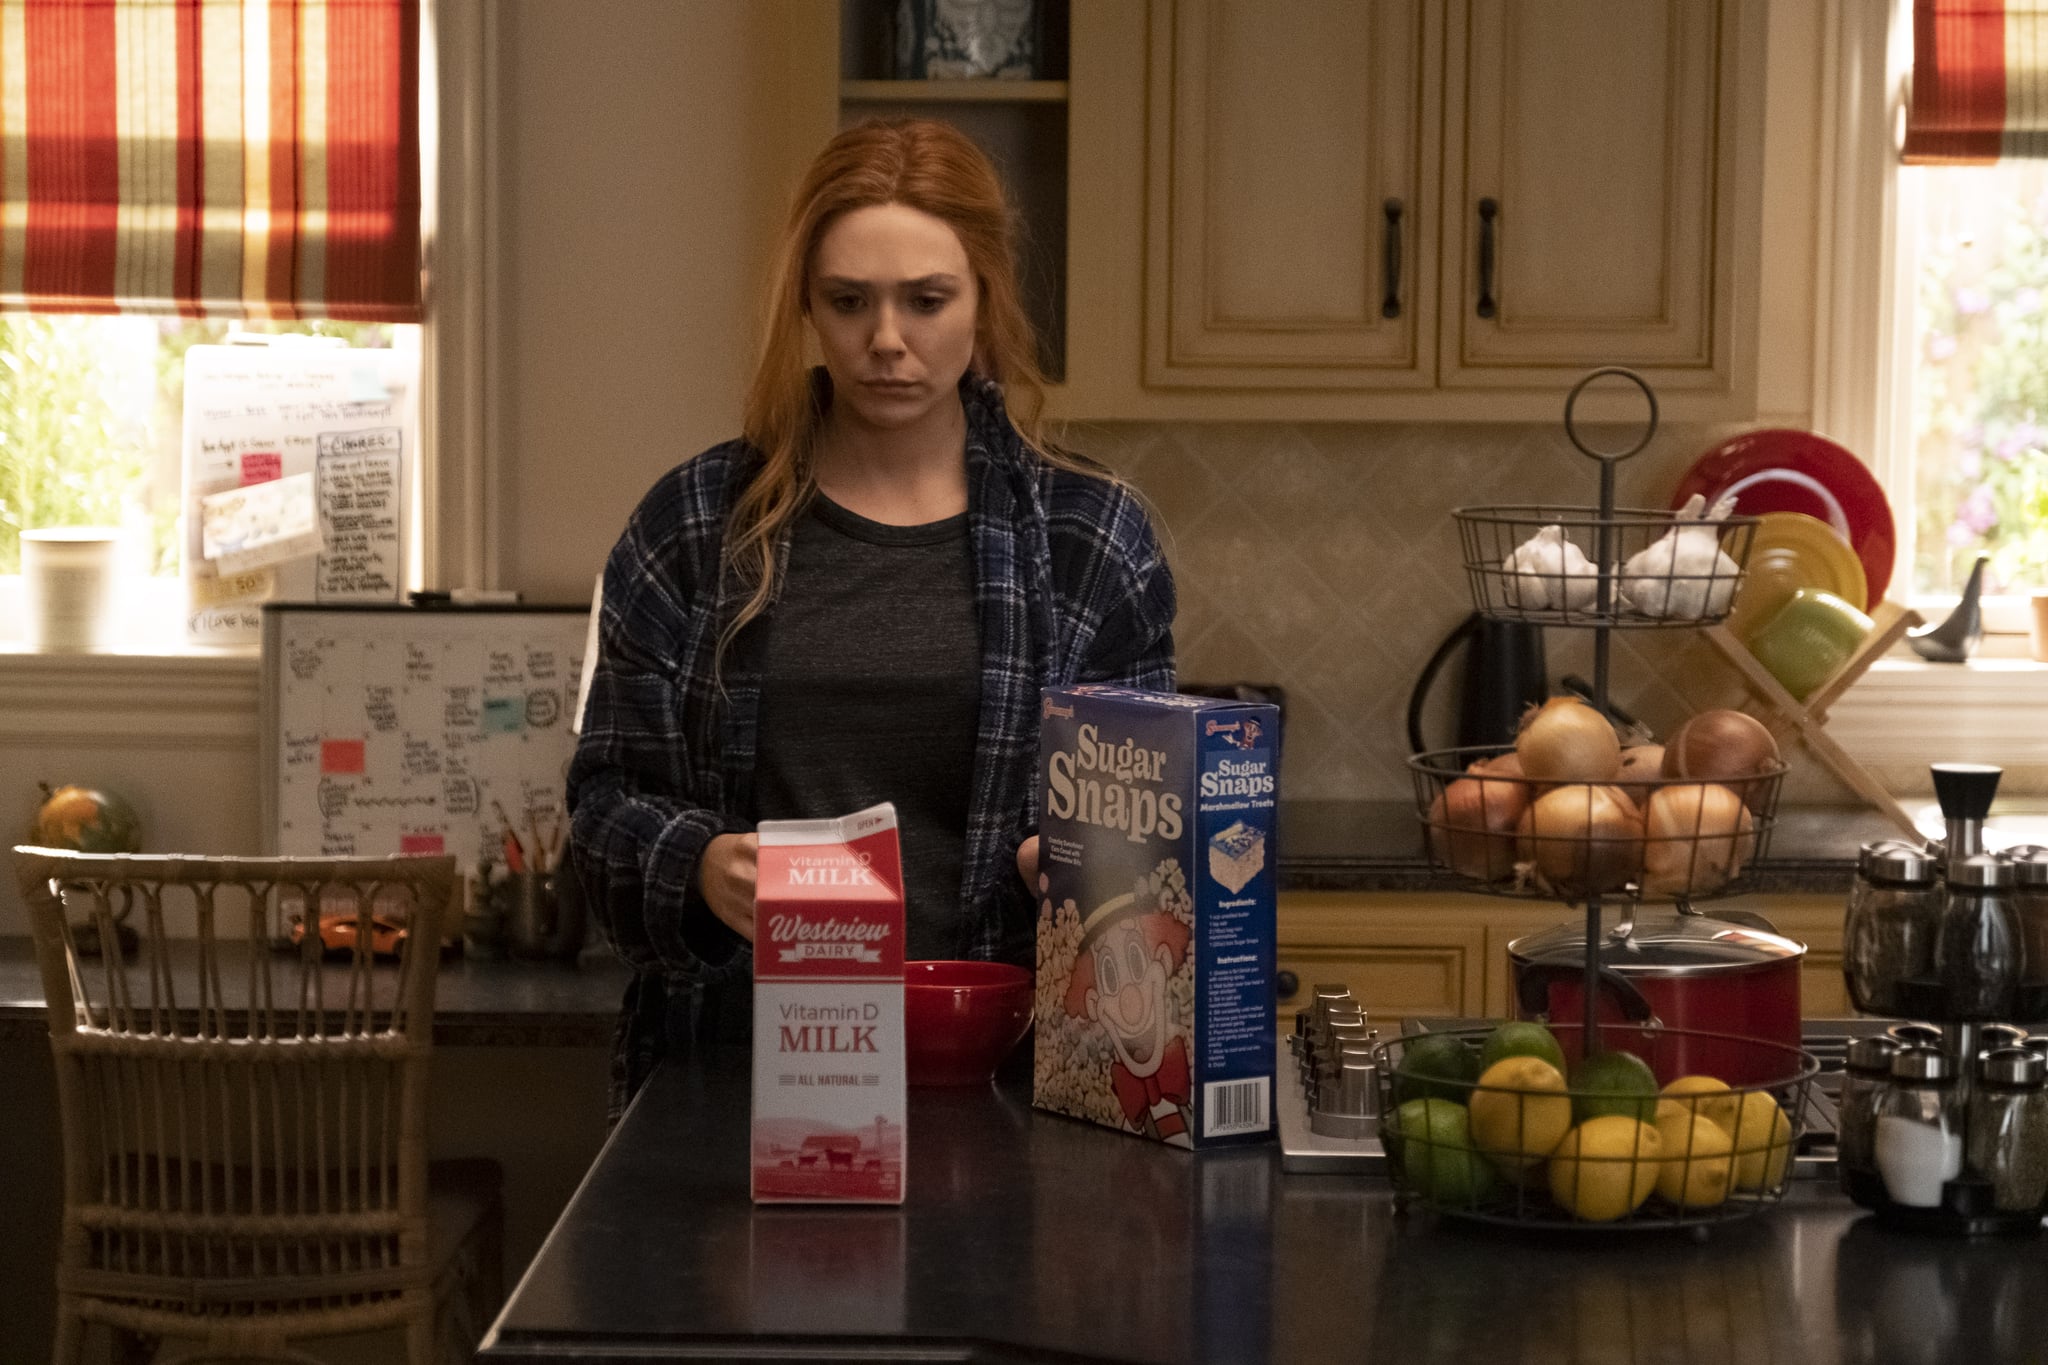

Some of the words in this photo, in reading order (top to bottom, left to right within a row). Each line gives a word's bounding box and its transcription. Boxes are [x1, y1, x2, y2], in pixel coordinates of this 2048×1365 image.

[1077, 723, 1167, 784] Sugar
[1218, 760, 1267, 777] Sugar
[1200, 772, 1274, 797] Snaps
[1048, 750, 1183, 844] Snaps
[1200, 801, 1250, 812] Marshmallow
[1251, 799, 1274, 809] Treats
[857, 820, 874, 831] OPEN
[788, 856, 857, 867] Vitamin
[788, 868, 873, 886] MILK
[768, 914, 890, 942] Westview
[804, 945, 856, 957] DAIRY
[779, 1004, 859, 1021] Vitamin
[863, 1004, 879, 1021] D
[778, 1026, 879, 1053] MILK
[798, 1075, 815, 1086] ALL
[817, 1075, 861, 1086] NATURAL
